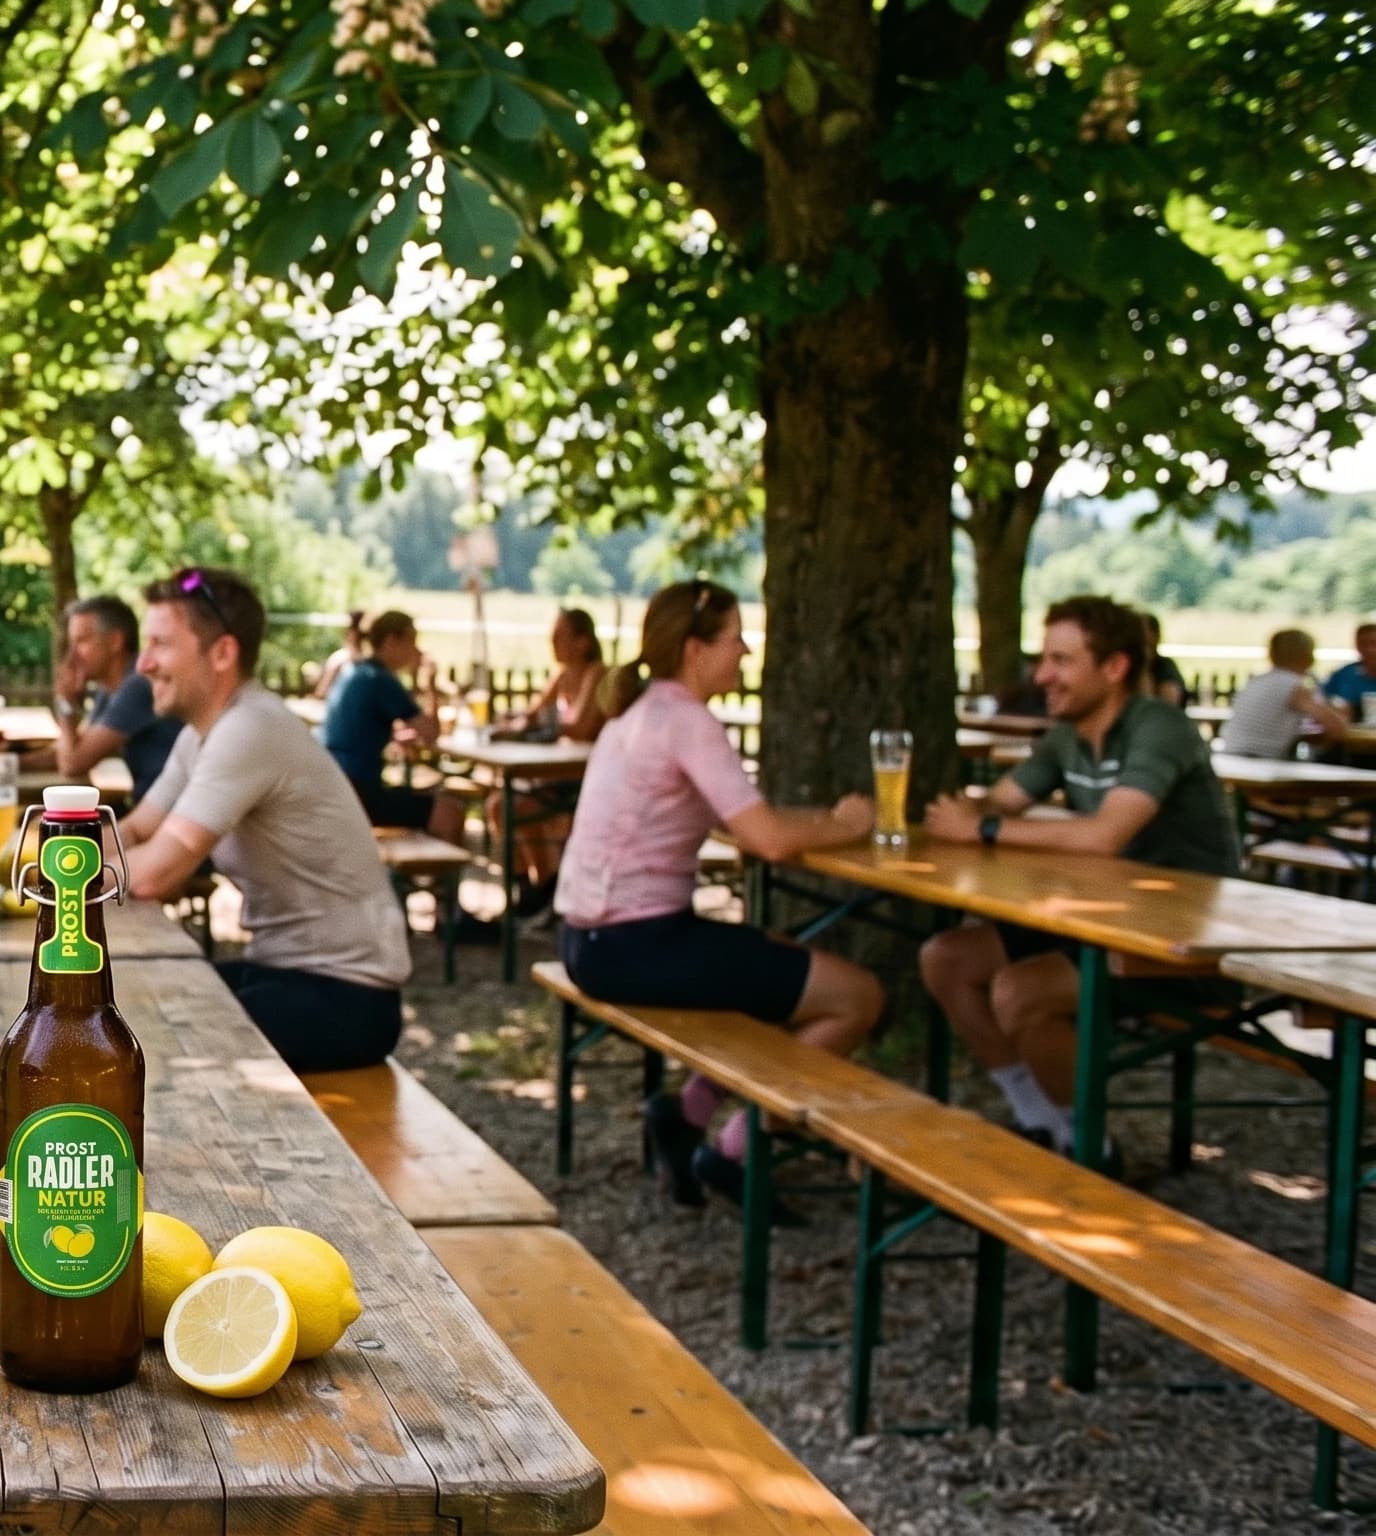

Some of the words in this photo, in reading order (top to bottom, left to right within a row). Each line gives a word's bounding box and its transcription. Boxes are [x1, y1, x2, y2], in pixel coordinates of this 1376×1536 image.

[61, 887, 79, 957] PROST
[45, 1142, 97, 1155] PROST
[27, 1154, 115, 1190] RADLER
[38, 1190, 107, 1207] NATUR
